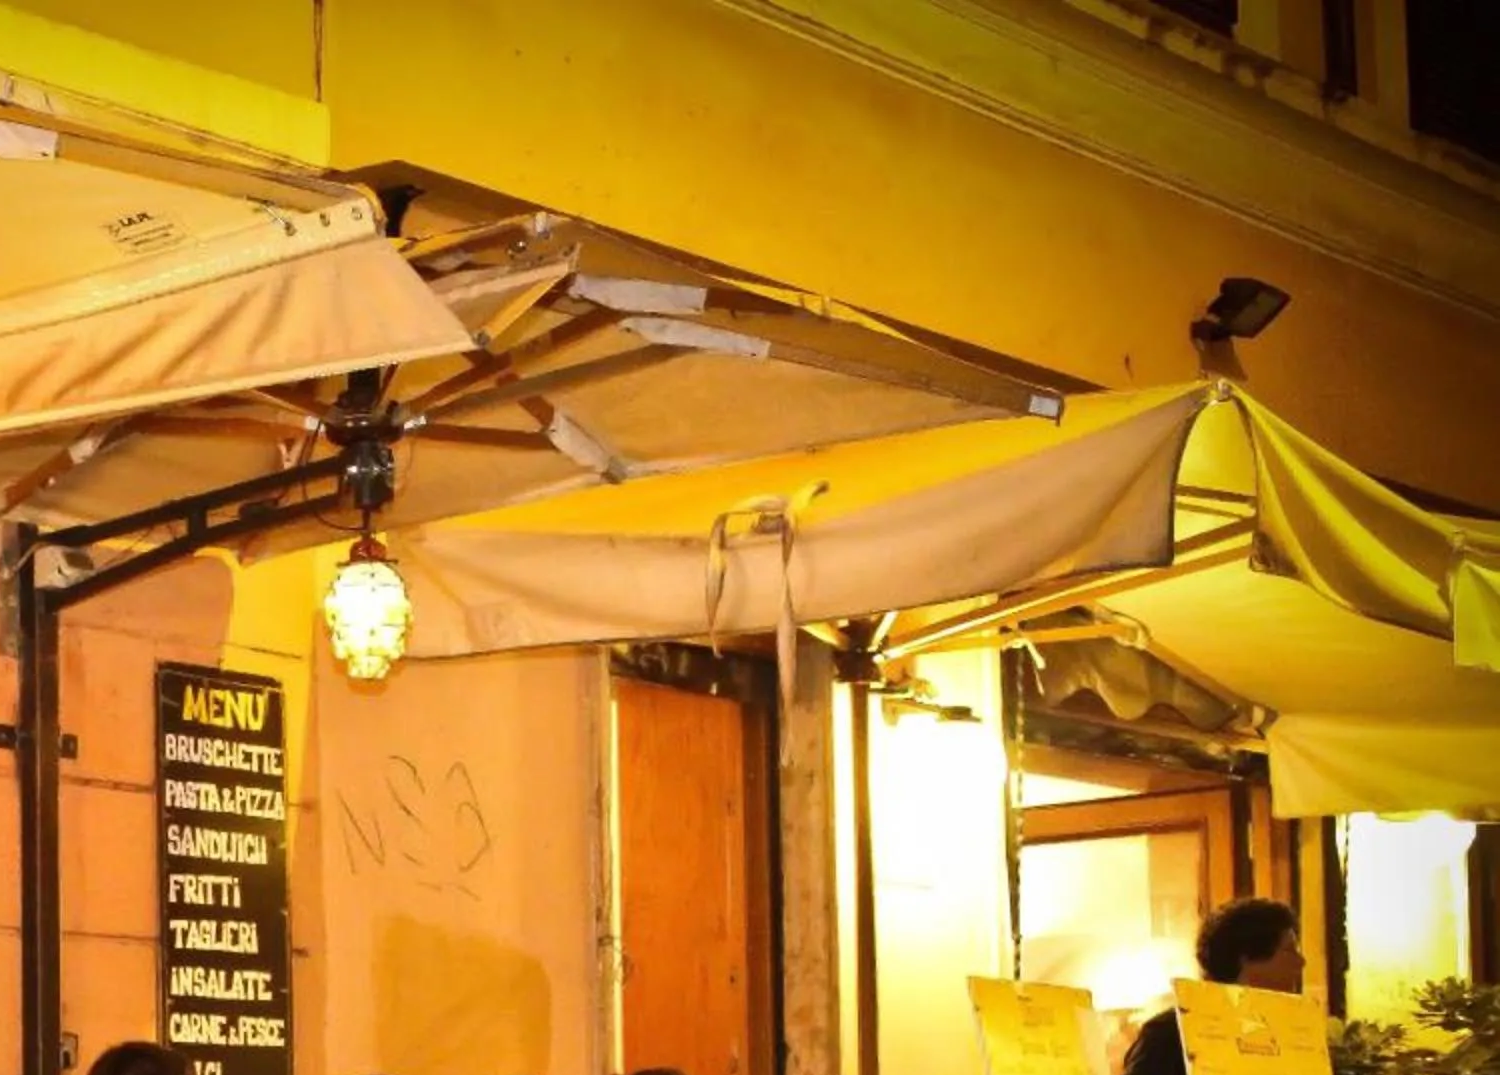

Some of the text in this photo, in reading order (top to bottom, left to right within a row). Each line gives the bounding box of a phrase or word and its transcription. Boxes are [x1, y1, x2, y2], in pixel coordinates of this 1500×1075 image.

[165, 733, 283, 776] BRUSCHETTE
[167, 824, 267, 865] SANDWICH
[168, 873, 241, 908] FRITTI
[169, 919, 259, 954] TAGLIERI
[170, 966, 272, 1001] INSALATE
[170, 1012, 227, 1045] CARNE
